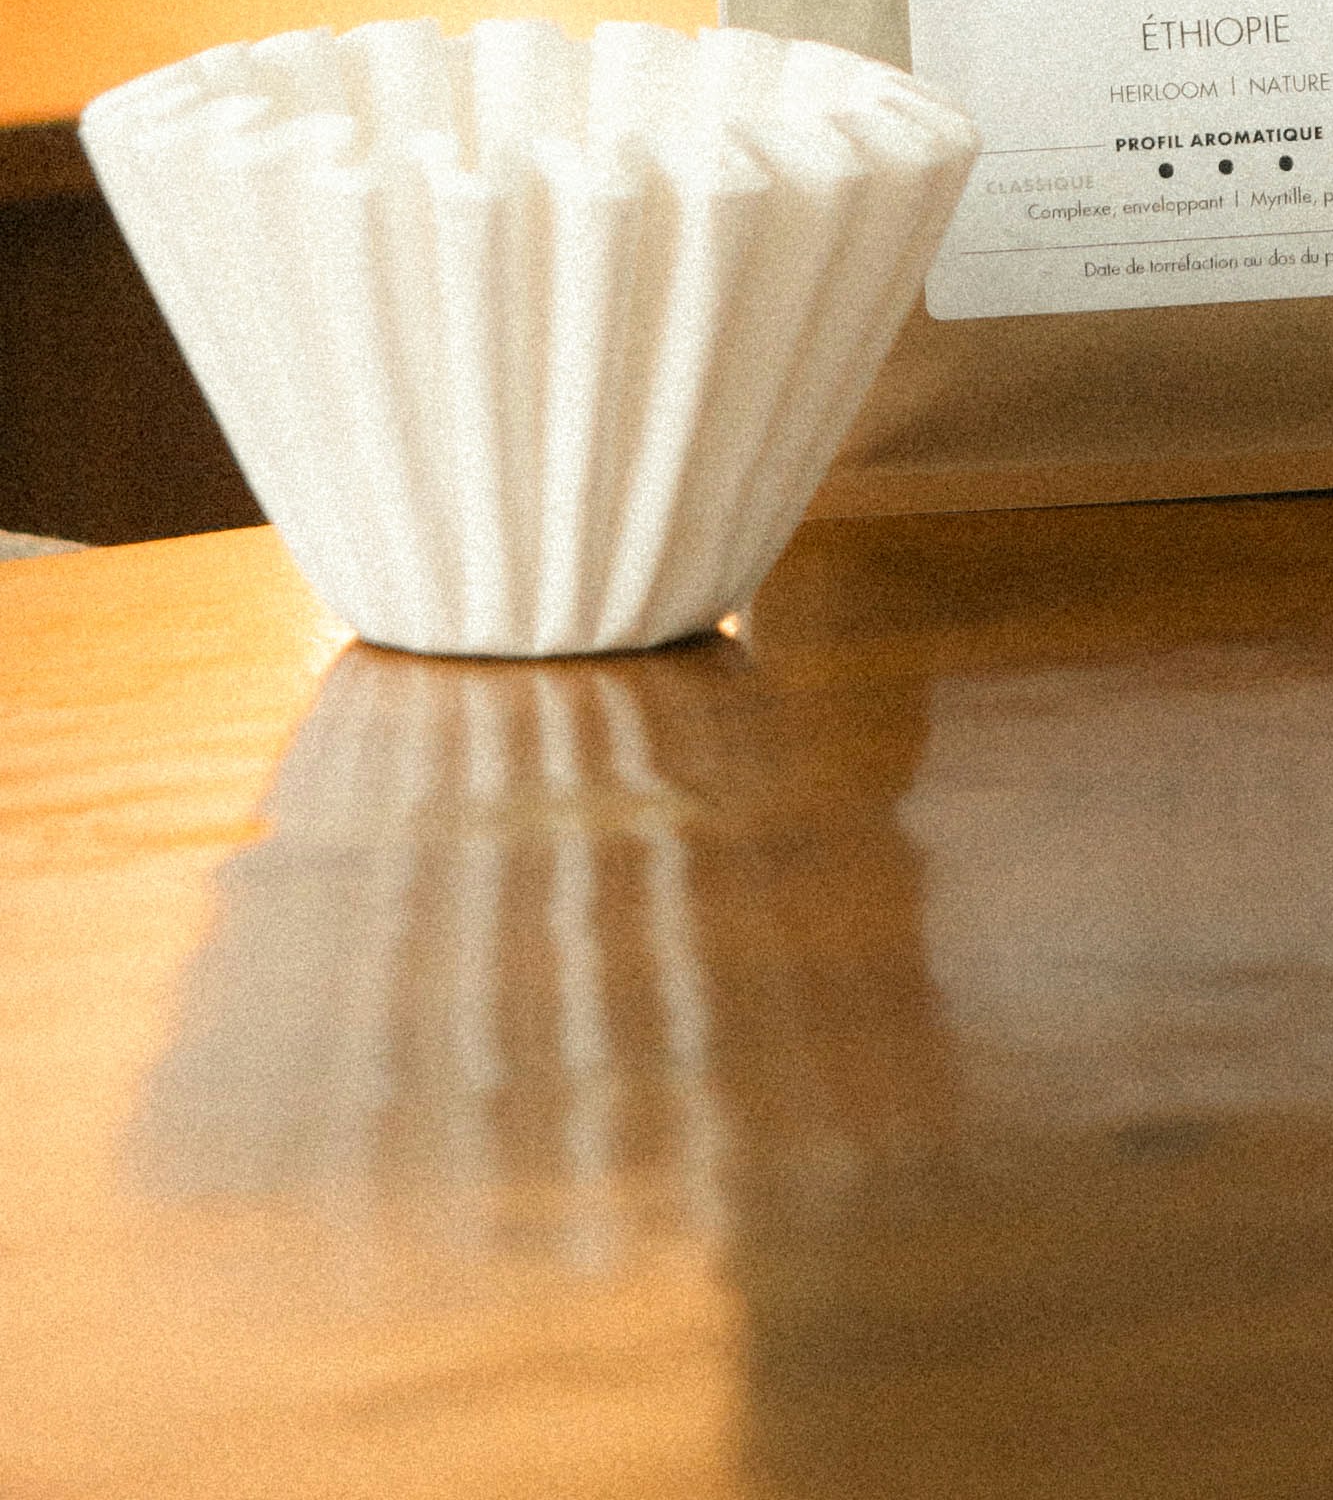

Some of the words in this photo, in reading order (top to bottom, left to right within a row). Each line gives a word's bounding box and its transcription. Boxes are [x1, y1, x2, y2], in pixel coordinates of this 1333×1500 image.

[1142, 13, 1291, 51] ÉTHIOPIE
[1109, 80, 1219, 103] HEIRLOOM
[1249, 72, 1331, 95] NATURE
[1116, 133, 1184, 152] PROFIL
[1190, 126, 1324, 148] AROMATIQUE
[986, 175, 1094, 195] CLASSIQUE
[1028, 200, 1118, 221] Complexe,
[1123, 195, 1224, 216] enveloppant
[1249, 186, 1318, 211] Myrtille,
[1084, 261, 1120, 278] Date
[1125, 257, 1146, 275] de
[1149, 253, 1239, 274] torréfaction
[1243, 256, 1263, 268] au
[1268, 248, 1296, 267] dos
[1300, 247, 1320, 265] du
